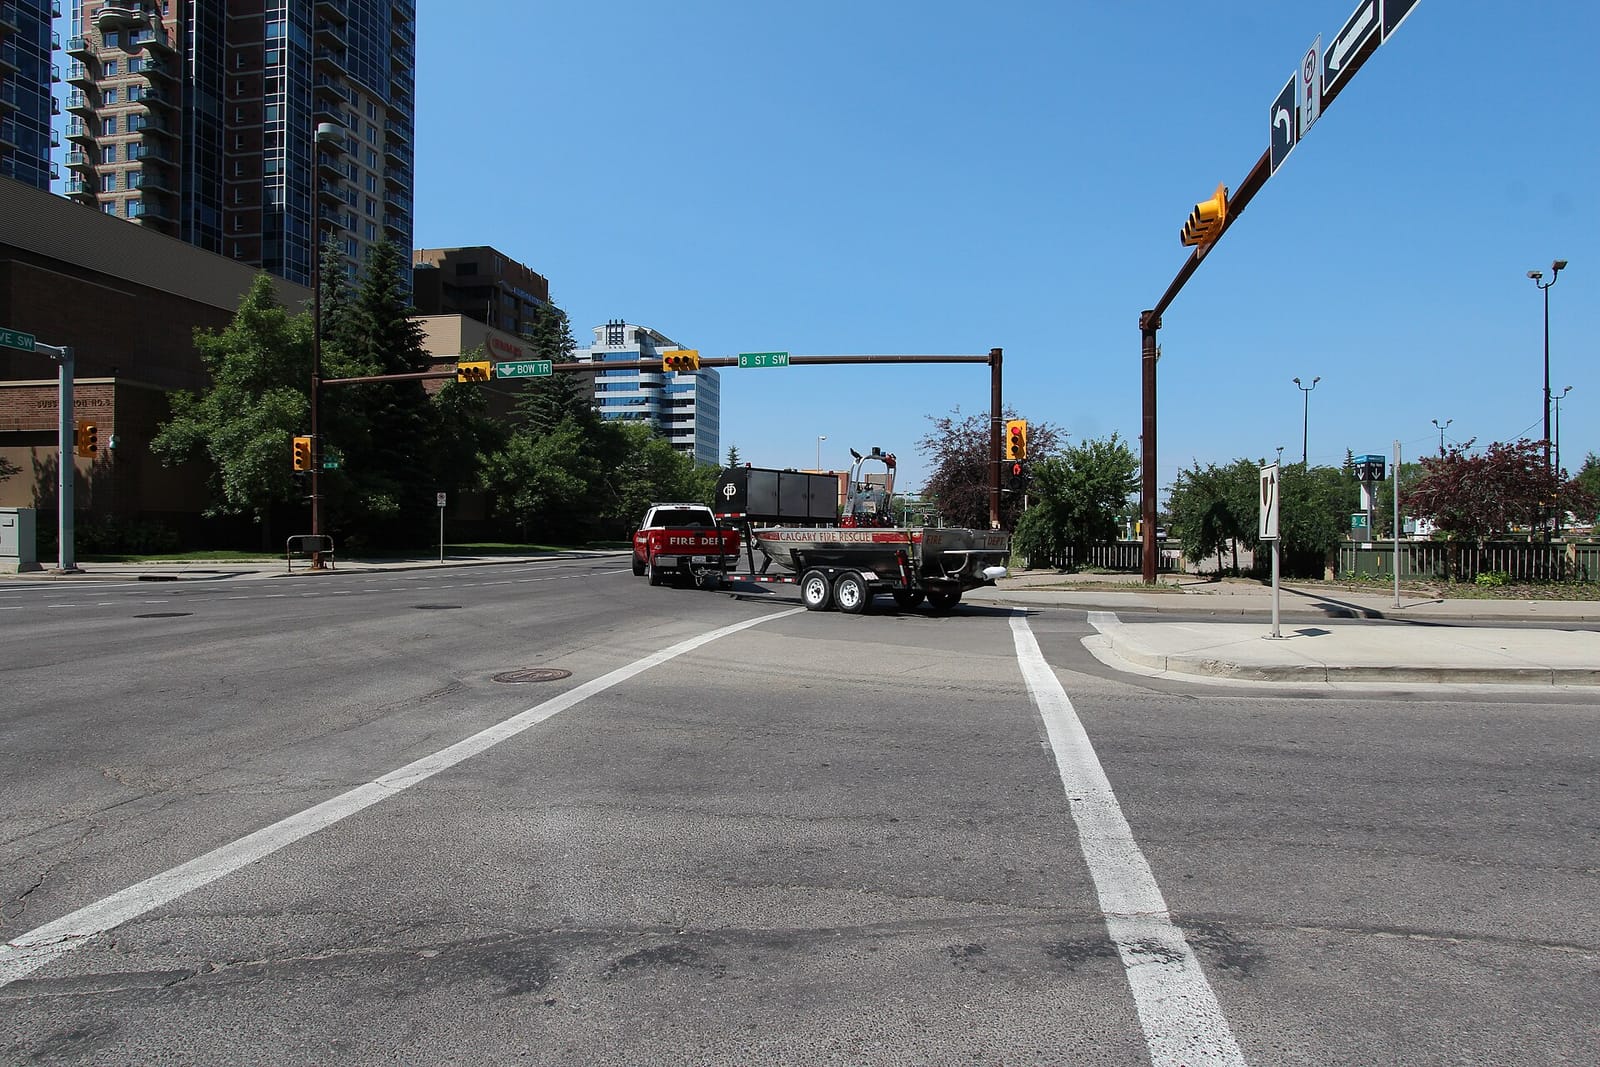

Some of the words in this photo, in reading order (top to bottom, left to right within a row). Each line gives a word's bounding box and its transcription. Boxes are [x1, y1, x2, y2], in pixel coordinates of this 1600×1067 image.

[17, 335, 33, 347] SW
[741, 356, 748, 366] 8
[755, 355, 767, 365] ST
[772, 354, 786, 364] SW
[517, 364, 535, 374] BOW
[539, 363, 549, 373] TR
[669, 537, 695, 545] FIRE
[780, 531, 816, 541] CALGARY
[819, 532, 838, 542] FIRE
[840, 532, 870, 542] RESCUE
[927, 535, 943, 545] FIRE
